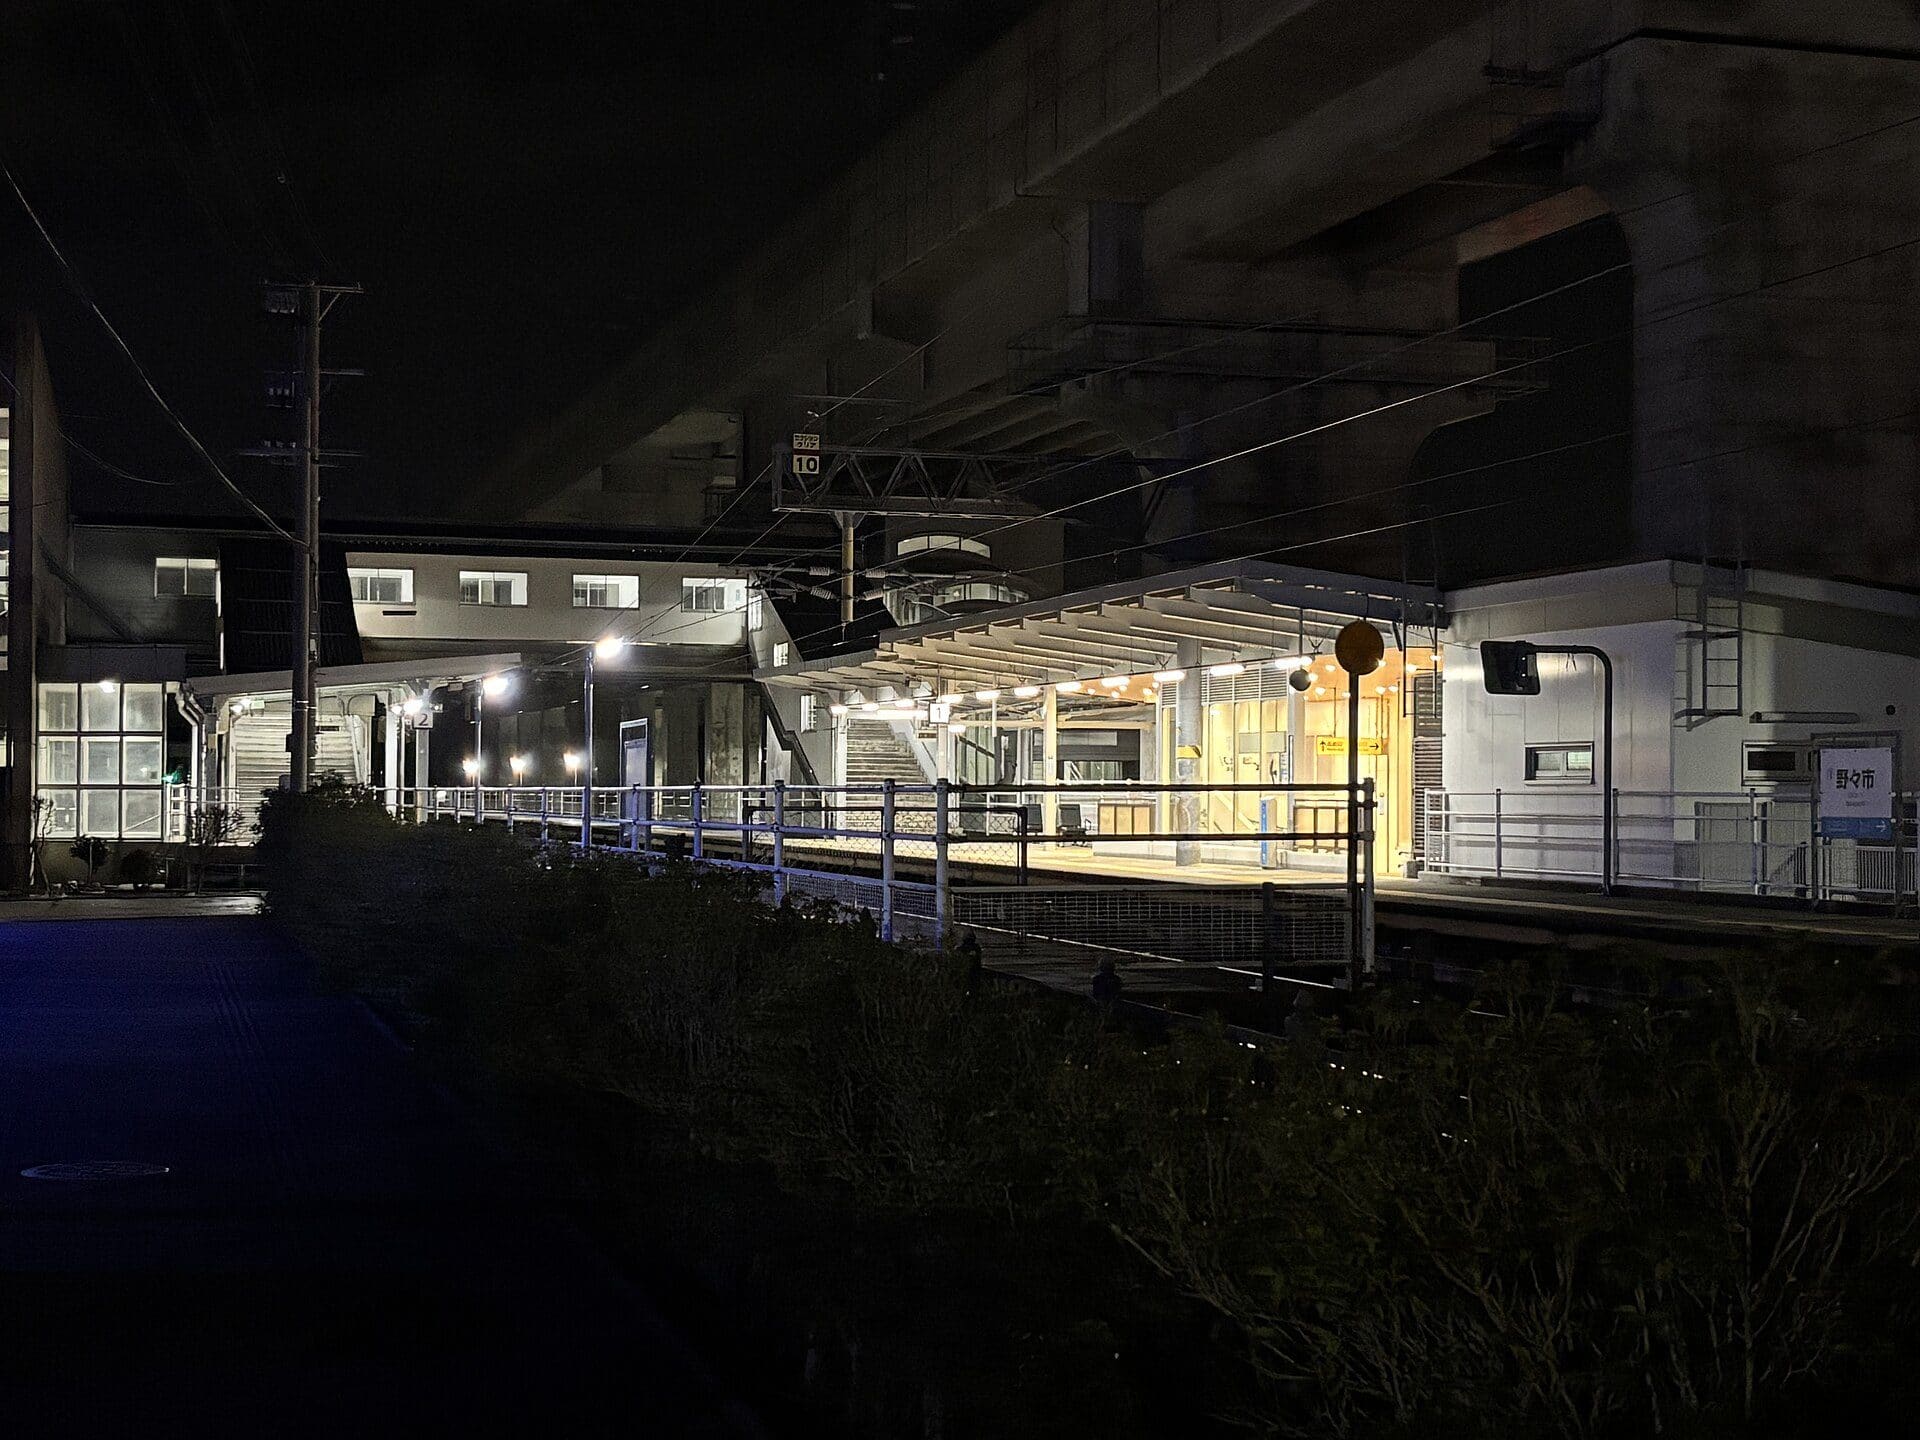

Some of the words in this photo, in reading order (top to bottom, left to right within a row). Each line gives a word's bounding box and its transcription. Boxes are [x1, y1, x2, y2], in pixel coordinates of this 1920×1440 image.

[796, 456, 818, 472] 10
[418, 713, 429, 726] 2
[935, 707, 941, 719] 1
[1836, 768, 1875, 789] 野々市
